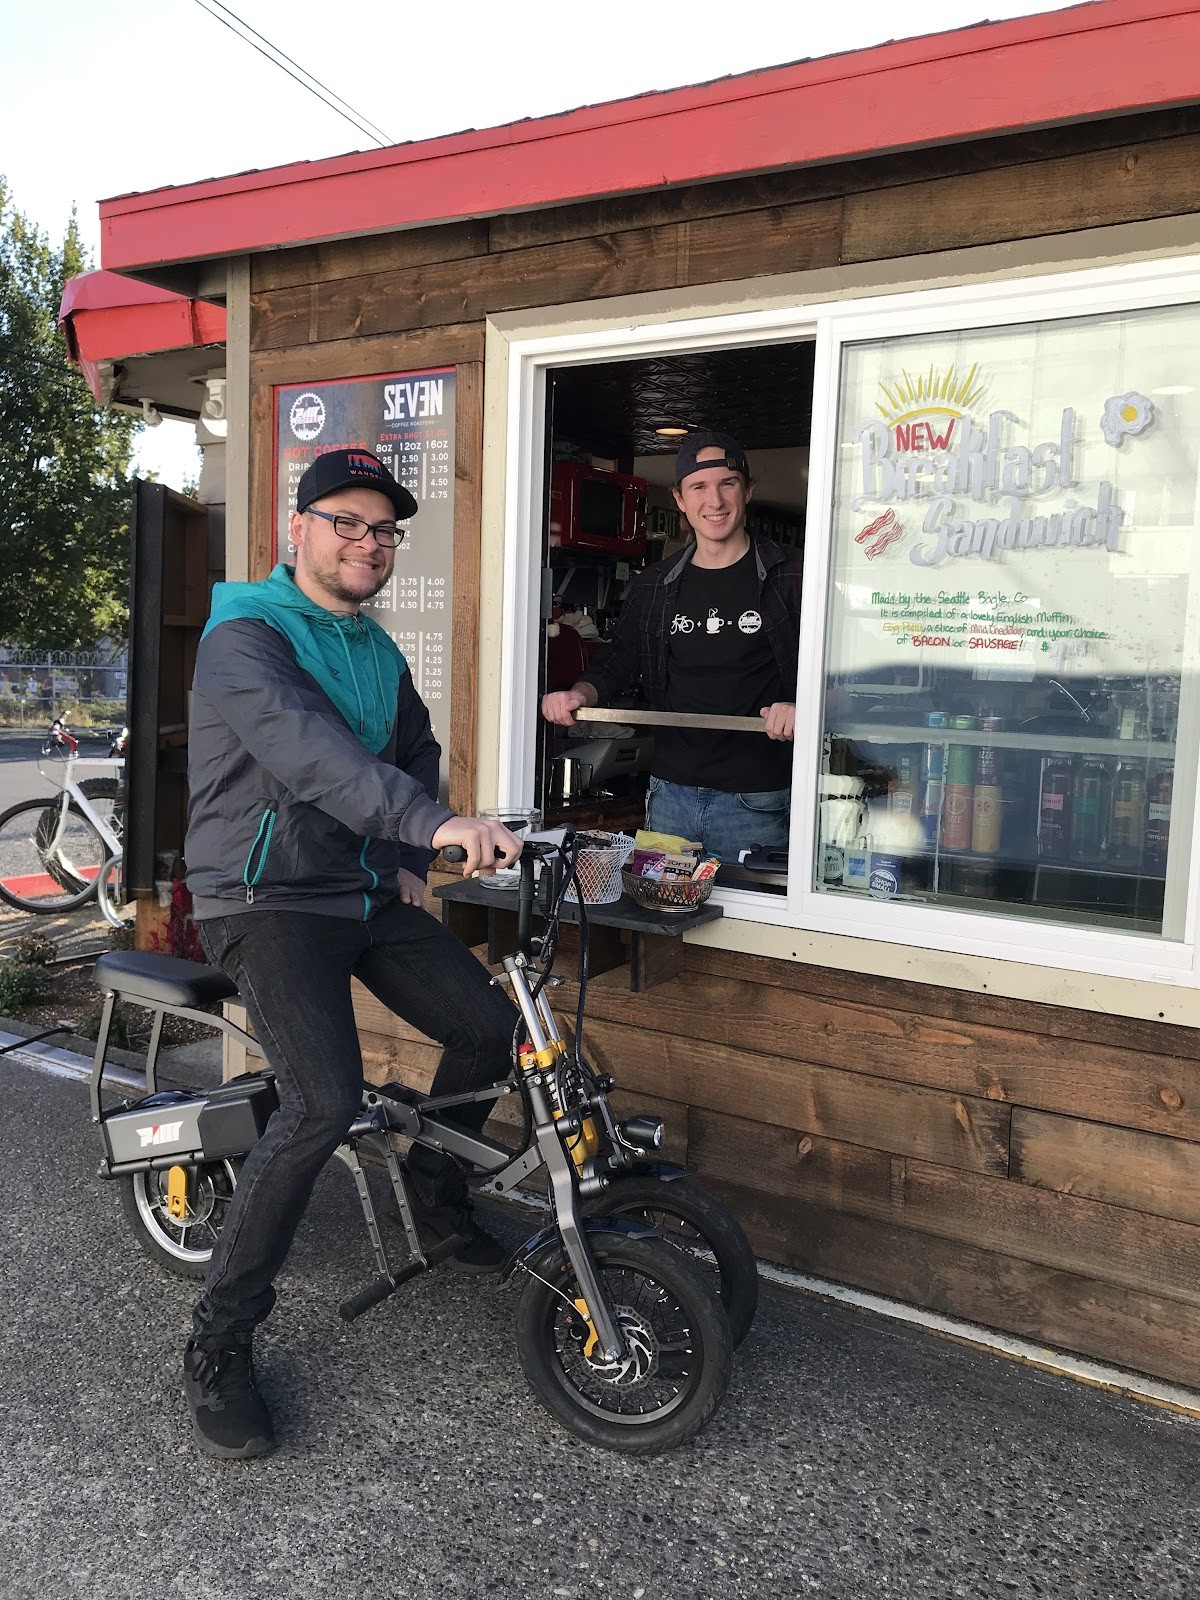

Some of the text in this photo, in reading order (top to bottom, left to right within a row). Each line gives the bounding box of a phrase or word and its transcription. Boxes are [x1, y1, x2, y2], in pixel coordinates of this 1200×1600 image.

[384, 379, 443, 420] SEVEN
[380, 433, 402, 441] EXTRA
[404, 431, 422, 440] SHOT
[896, 418, 956, 451] NEW
[399, 441, 421, 451] 12OZ
[426, 439, 448, 449] 16OZ
[401, 454, 418, 463] 2.50
[431, 452, 448, 461] 3.00
[851, 407, 1074, 513] Breakfast
[349, 469, 381, 479] WAND
[401, 467, 418, 475] 2.75
[430, 465, 448, 474] 3.75
[430, 478, 448, 487] 4.50
[430, 490, 448, 499] 4.75
[657, 508, 678, 537] EXIT
[909, 481, 1125, 567] Sandwich
[400, 578, 418, 586] 3.75
[427, 577, 445, 586] 4.00
[400, 589, 417, 598] 3.00
[427, 589, 445, 598] 4.00
[374, 601, 444, 610] 4.25 4.50 4.75
[872, 591, 895, 605] Made
[899, 592, 911, 610] by
[914, 592, 931, 604] the
[938, 591, 970, 605] Seattle
[1014, 592, 1028, 603] Co
[880, 608, 888, 618] It
[891, 608, 899, 618] is
[900, 608, 942, 620] compiled
[946, 608, 957, 619] of
[960, 612, 968, 620] a
[970, 610, 994, 626] lovely
[996, 611, 1033, 627] English
[399, 632, 443, 641] 4.50 4.75
[883, 622, 900, 636] Egg
[927, 624, 933, 632] a
[935, 623, 955, 632] slice
[957, 623, 968, 633] of
[1026, 627, 1045, 638] and
[1049, 629, 1071, 641] your
[896, 633, 1024, 651] of BACON or SAUSAGE!
[425, 644, 443, 653] 4.00
[425, 656, 442, 665] 4.25
[425, 668, 442, 676] 3.25
[425, 680, 442, 688] 3.00
[425, 691, 442, 700] 3.00
[947, 815, 962, 824] IZZE
[874, 876, 892, 888] SHOP
